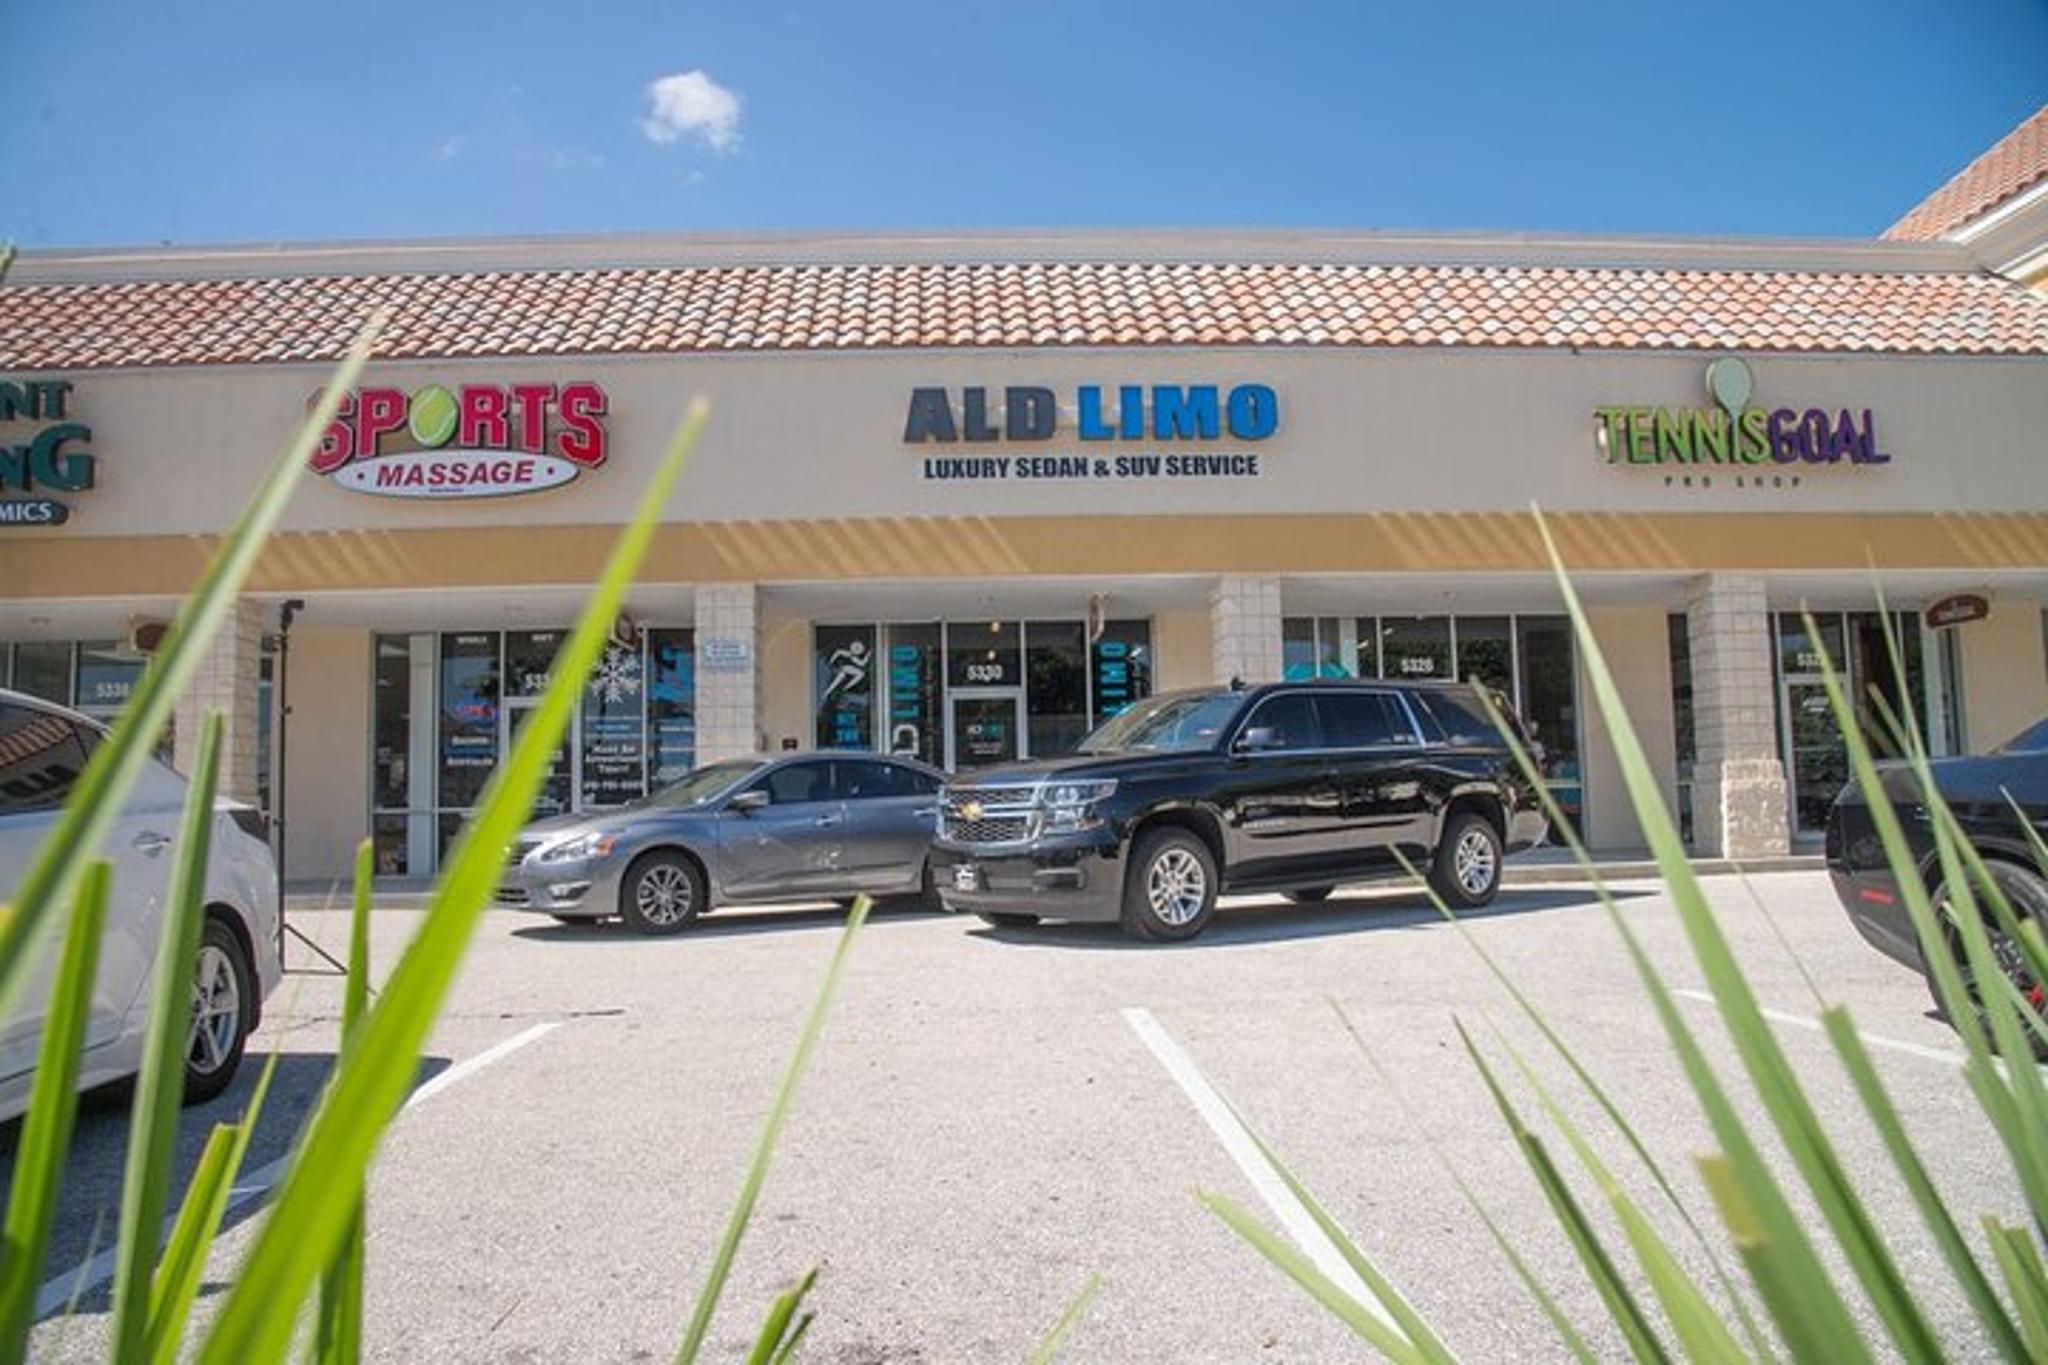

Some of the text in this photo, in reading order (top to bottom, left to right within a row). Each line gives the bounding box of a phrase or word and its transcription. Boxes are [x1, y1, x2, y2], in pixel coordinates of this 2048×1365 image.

[903, 383, 1279, 443] ALD LIMO
[376, 460, 536, 487] MASSAGE
[924, 453, 1259, 479] LUXURY SEDAN & SUV SERVICE
